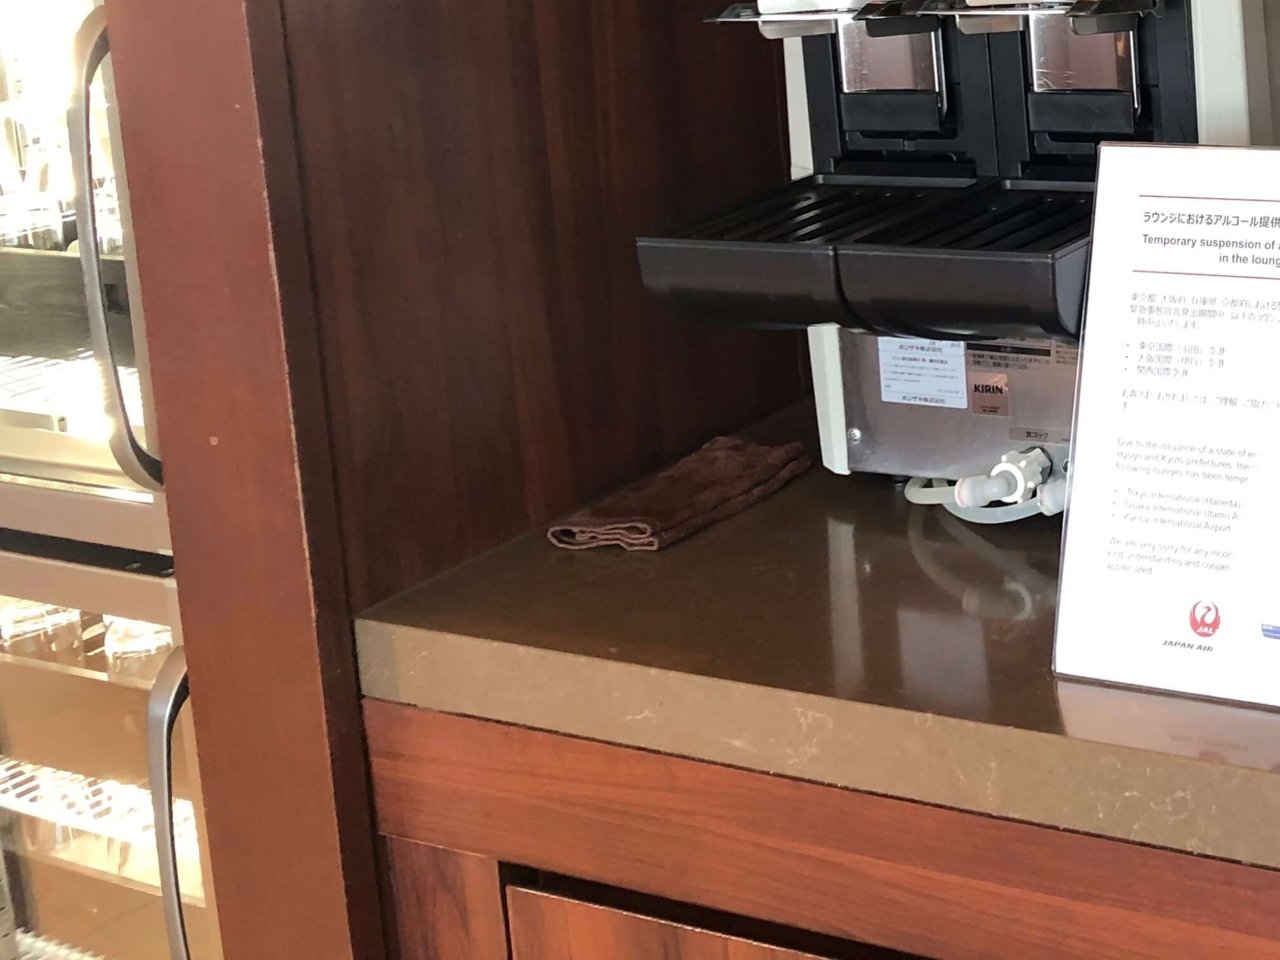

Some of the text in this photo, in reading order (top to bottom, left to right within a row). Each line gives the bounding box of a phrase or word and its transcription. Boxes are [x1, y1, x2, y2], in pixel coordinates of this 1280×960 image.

[1142, 233, 1198, 249] Temporary
[1199, 238, 1262, 250] suspension
[1264, 240, 1276, 251] of
[1219, 252, 1229, 263] in
[1231, 253, 1249, 264] the
[973, 383, 1004, 395] KIRIN
[1197, 626, 1215, 635] JAL
[1162, 640, 1195, 650] JAPAN
